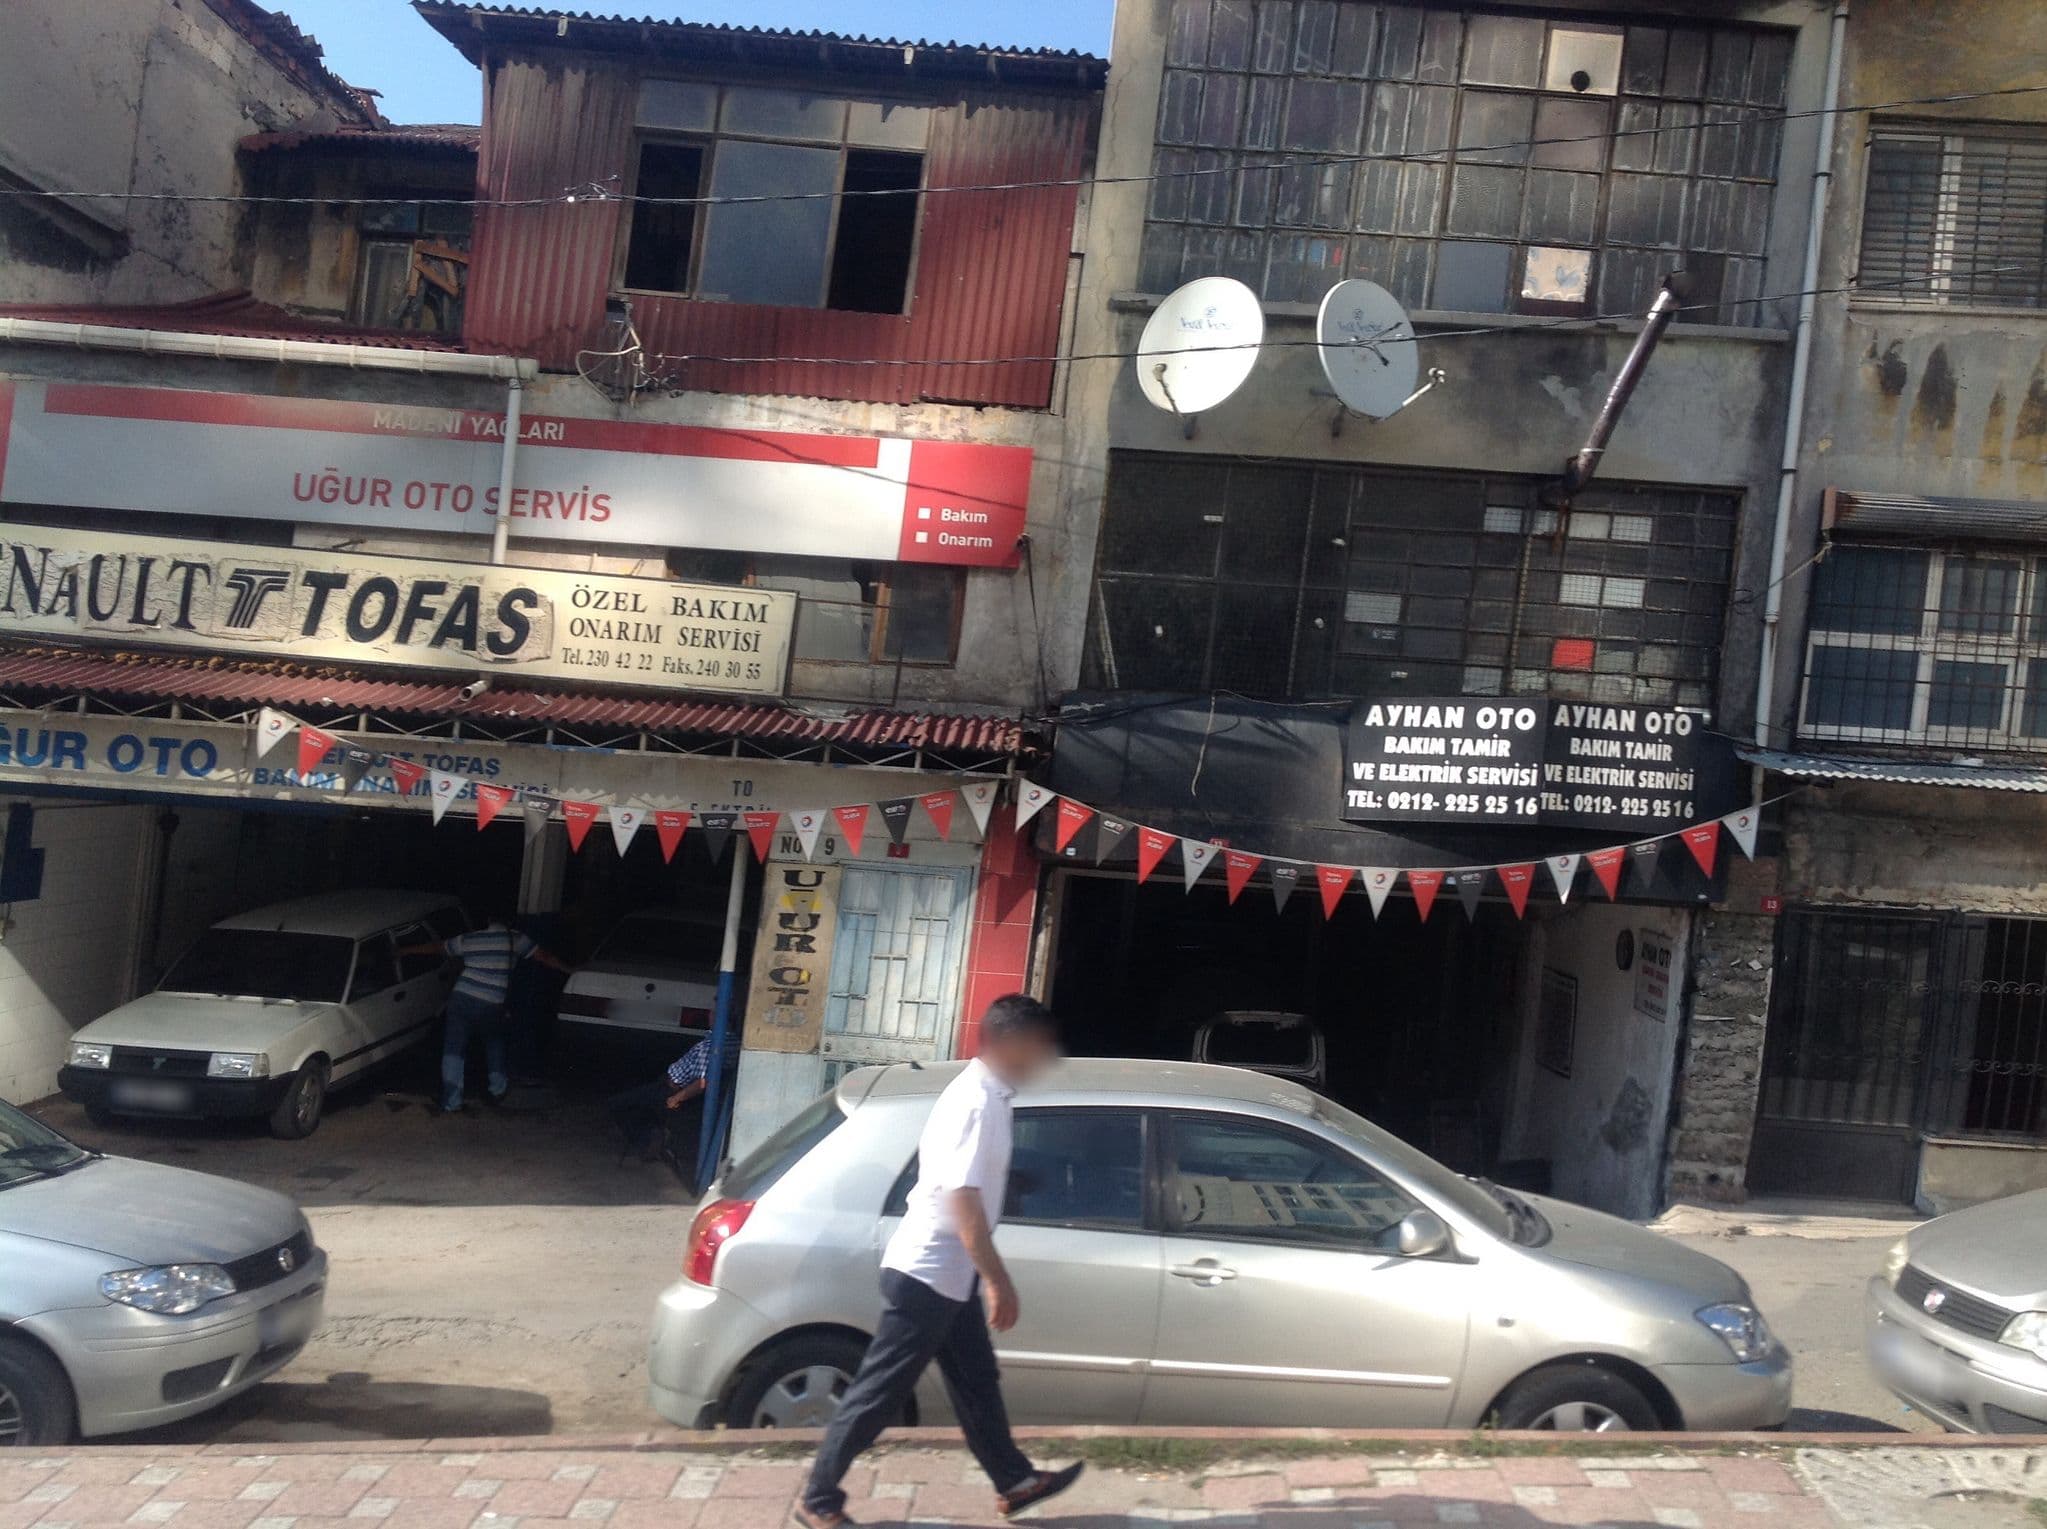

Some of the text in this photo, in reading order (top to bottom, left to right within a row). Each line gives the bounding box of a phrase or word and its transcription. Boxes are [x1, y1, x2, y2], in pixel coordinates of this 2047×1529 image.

[293, 467, 612, 523] UĞUR OTO SERVİS
[941, 508, 988, 524] Bakım
[938, 532, 993, 548] Onarım
[0, 543, 211, 629] NAULT
[571, 584, 768, 623] ÖZEL BAKIM
[570, 617, 762, 653] ONARIM SERVİSİ
[615, 652, 631, 669] 42
[637, 653, 653, 670] 22
[725, 660, 741, 679] 30
[746, 662, 761, 680] 55
[1364, 704, 1537, 731] AYHAN OTO
[1553, 704, 1693, 736] AYHAN OTO
[107, 734, 218, 777] OTO
[1383, 733, 1511, 757] BAKIM TAMİR
[1569, 737, 1674, 761] BAKIM TAMİR
[1352, 760, 1539, 786] VE ELEKTRİK SERVİSİ
[1544, 763, 1695, 791] VE ELEKTRİK SERVİSİ
[1347, 789, 1383, 809] TEL:
[1444, 793, 1480, 813] 225
[1485, 795, 1509, 815] 25
[1514, 797, 1539, 816] 16
[1540, 792, 1570, 811] TEL:
[1621, 797, 1649, 817] 225
[825, 837, 835, 856] 9
